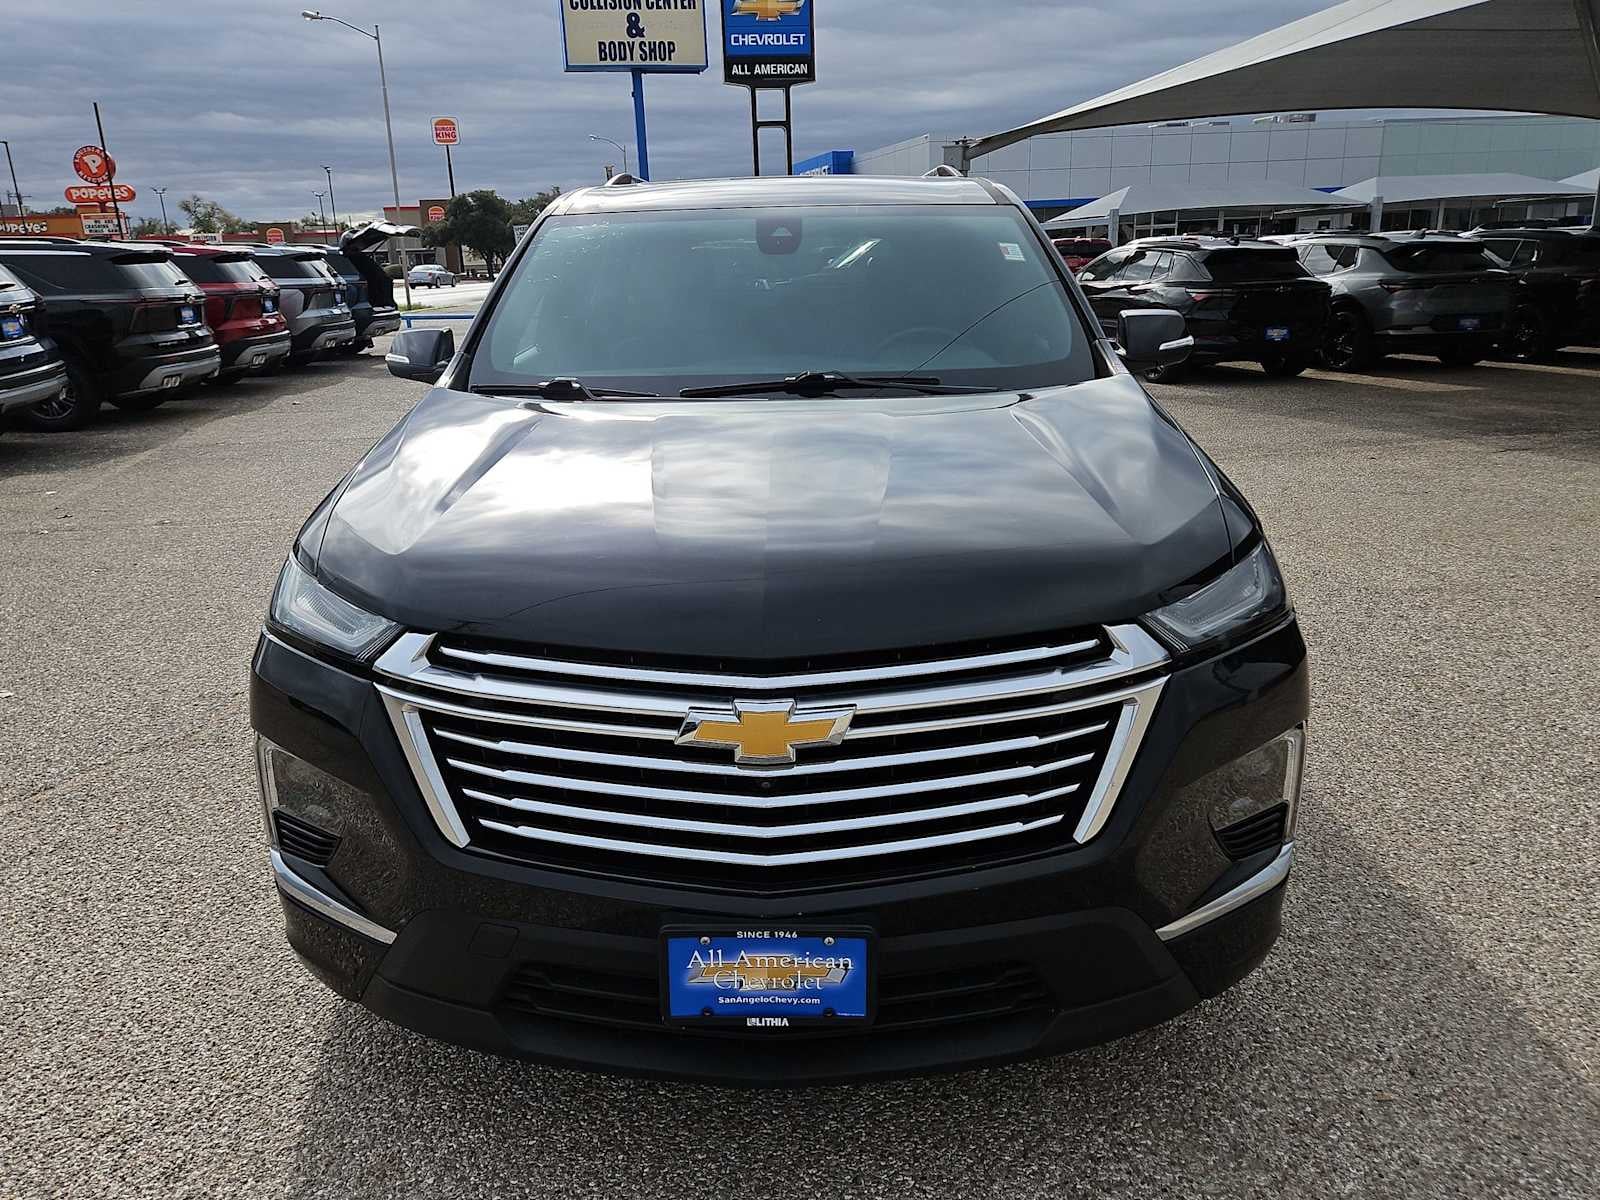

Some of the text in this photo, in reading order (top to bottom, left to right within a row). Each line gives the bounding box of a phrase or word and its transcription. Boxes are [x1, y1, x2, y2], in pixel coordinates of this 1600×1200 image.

[626, 12, 645, 38] &
[731, 33, 806, 46] CHEVROLET
[598, 41, 676, 61] BODY SHOP
[732, 63, 808, 75] ALL AMERICAN
[435, 131, 456, 139] KING
[736, 931, 798, 939] SINCE 1946
[686, 949, 854, 969] All American
[713, 970, 825, 990] Chevrolet
[718, 996, 821, 1005] SanAngeloChevy.com
[756, 1017, 789, 1027] LITHIA
